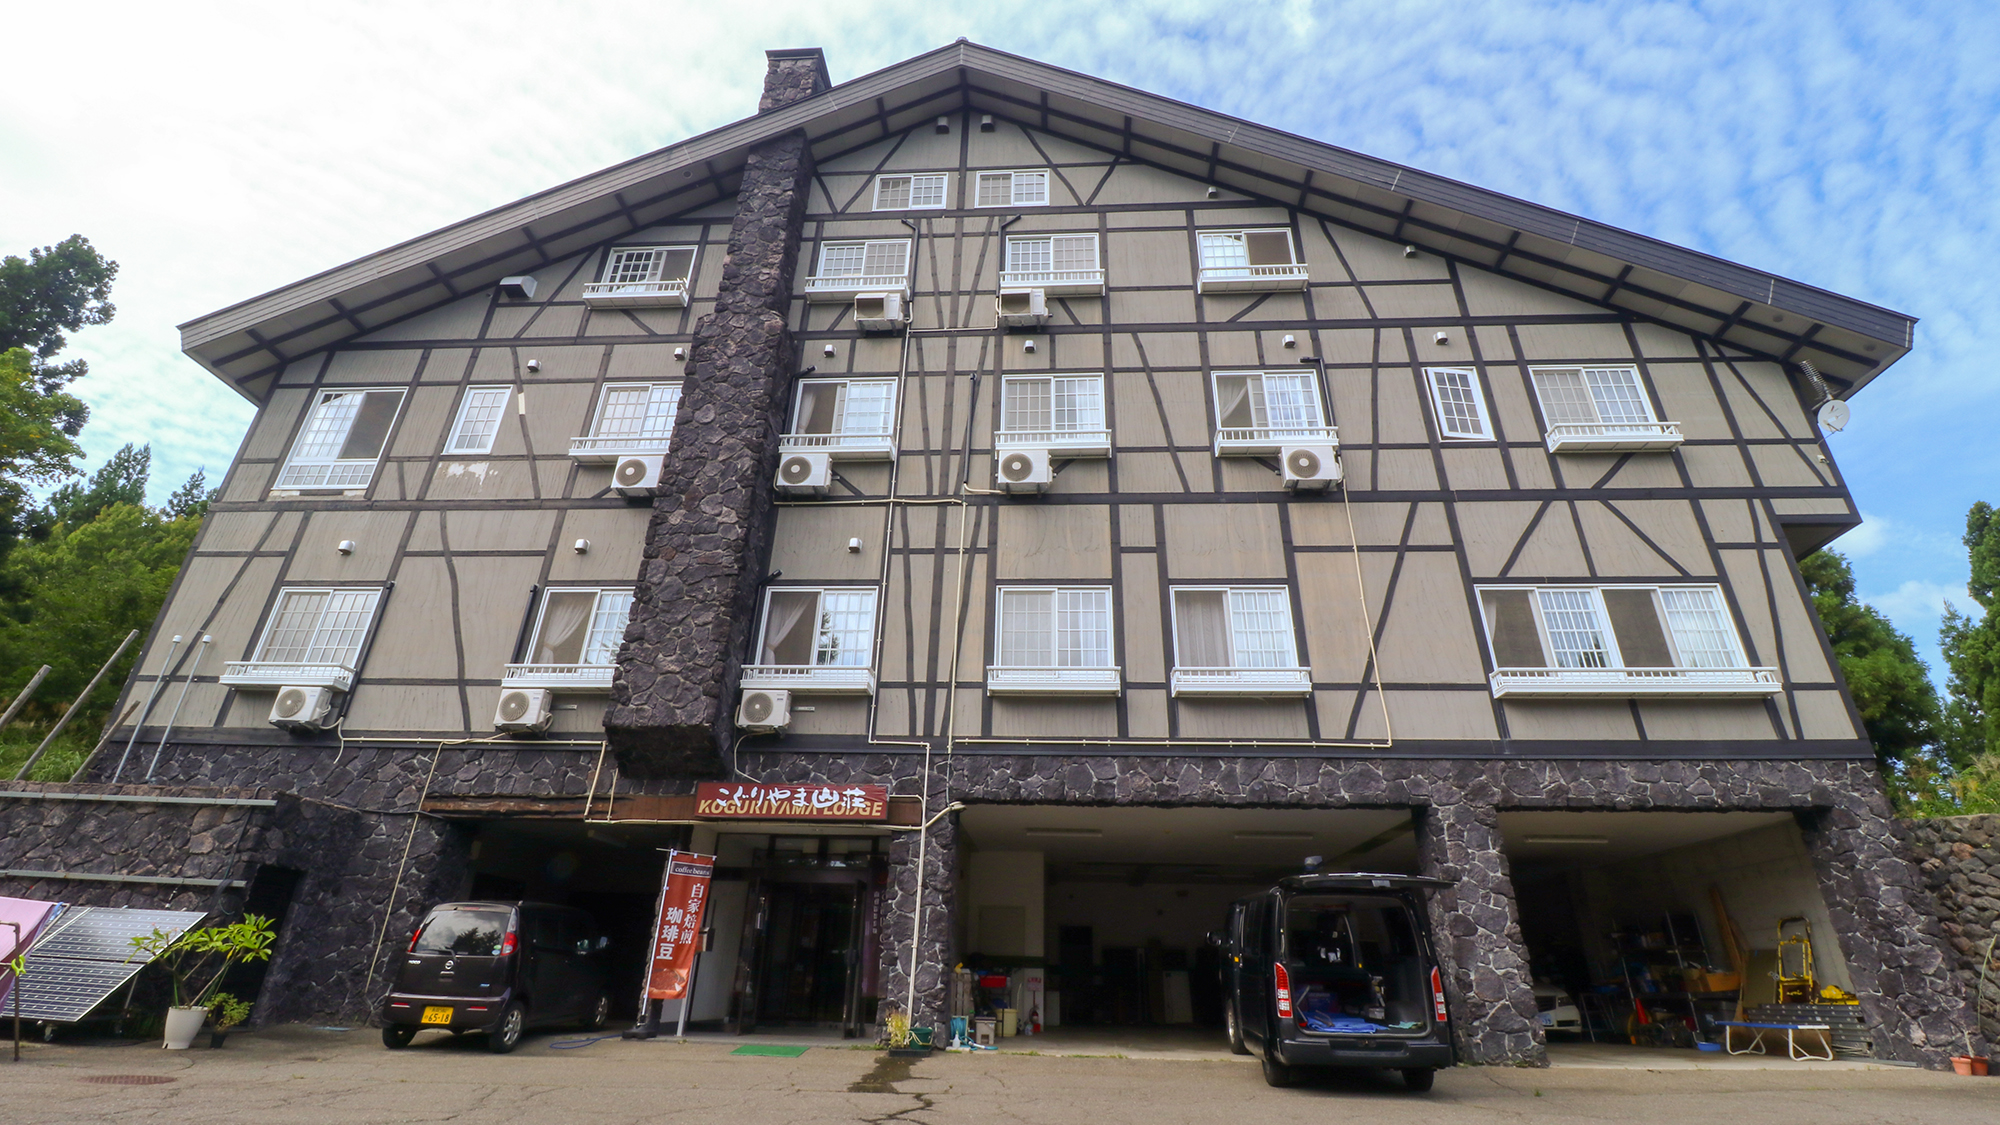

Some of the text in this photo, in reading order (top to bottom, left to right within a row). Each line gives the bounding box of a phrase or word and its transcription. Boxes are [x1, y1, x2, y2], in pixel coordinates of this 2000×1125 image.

[698, 799, 883, 816] KOGURIYAMA LODGE
[716, 785, 866, 809] こぐりやま山荘
[674, 866, 710, 875] coffee beans
[679, 883, 705, 944] 自家焙煎
[656, 907, 683, 960] 珈琲豆
